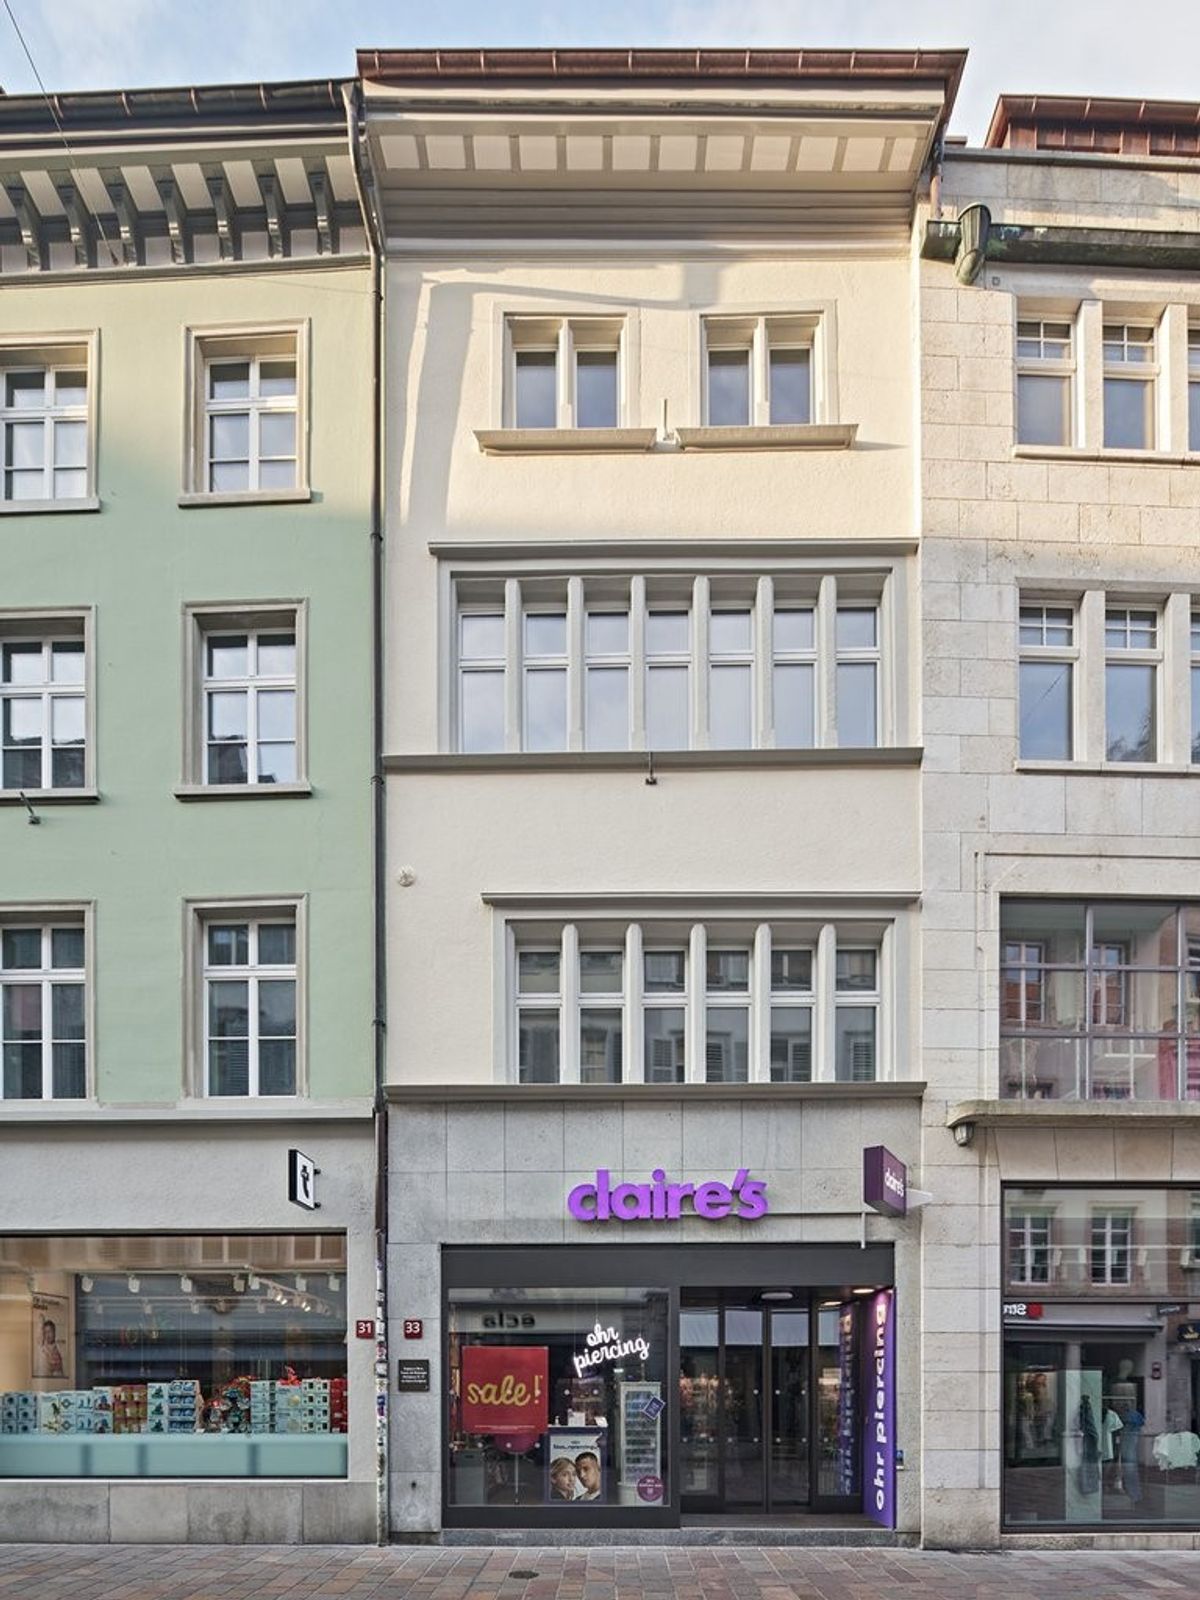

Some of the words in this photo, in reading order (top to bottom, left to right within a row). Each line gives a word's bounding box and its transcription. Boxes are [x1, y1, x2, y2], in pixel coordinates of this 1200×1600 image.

[568, 1168, 768, 1221] claire's
[358, 1322, 372, 1334] 31
[405, 1322, 420, 1334] 33
[586, 1322, 619, 1347] ohr
[573, 1337, 650, 1378] piercing
[873, 1303, 887, 1444] piercing
[873, 1452, 885, 1511] ohr
